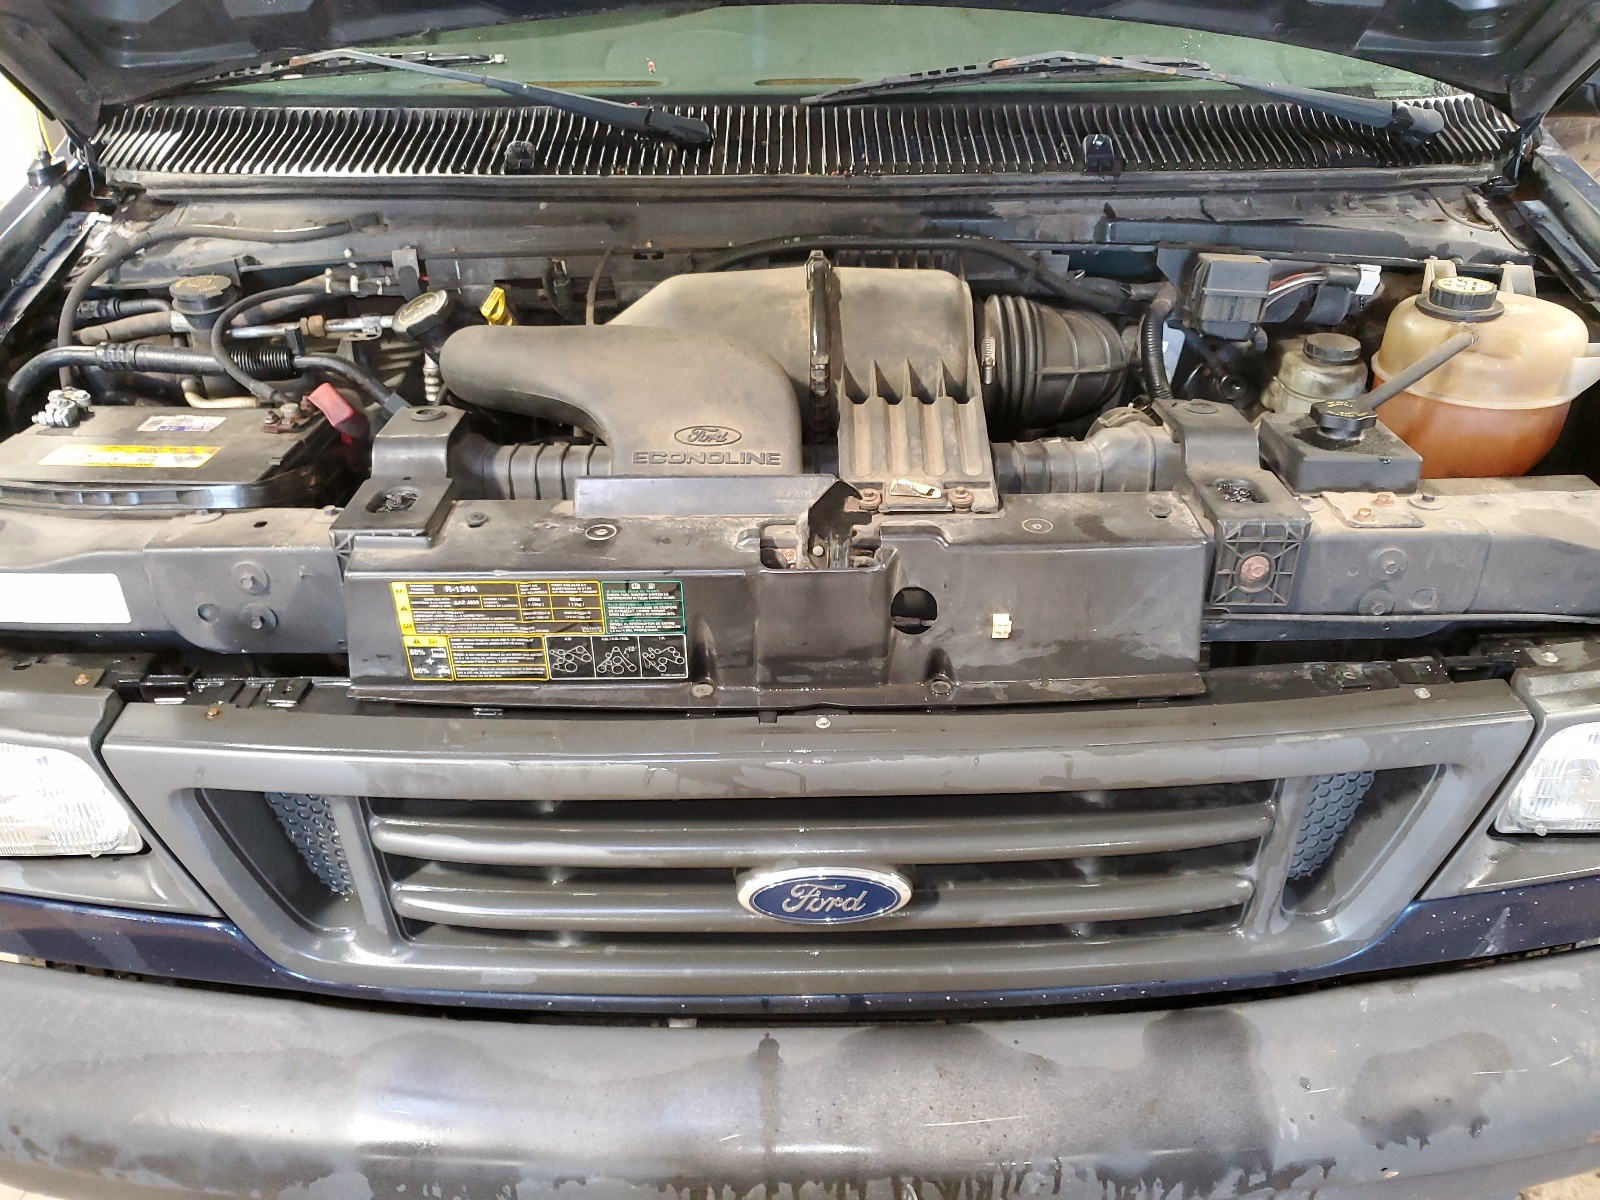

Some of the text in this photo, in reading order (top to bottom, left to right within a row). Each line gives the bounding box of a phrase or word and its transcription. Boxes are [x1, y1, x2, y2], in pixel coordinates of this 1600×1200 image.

[687, 427, 729, 443] Ford
[632, 451, 781, 466] ECONOLINE
[444, 585, 478, 593] R-134A
[781, 883, 867, 913] Ford
